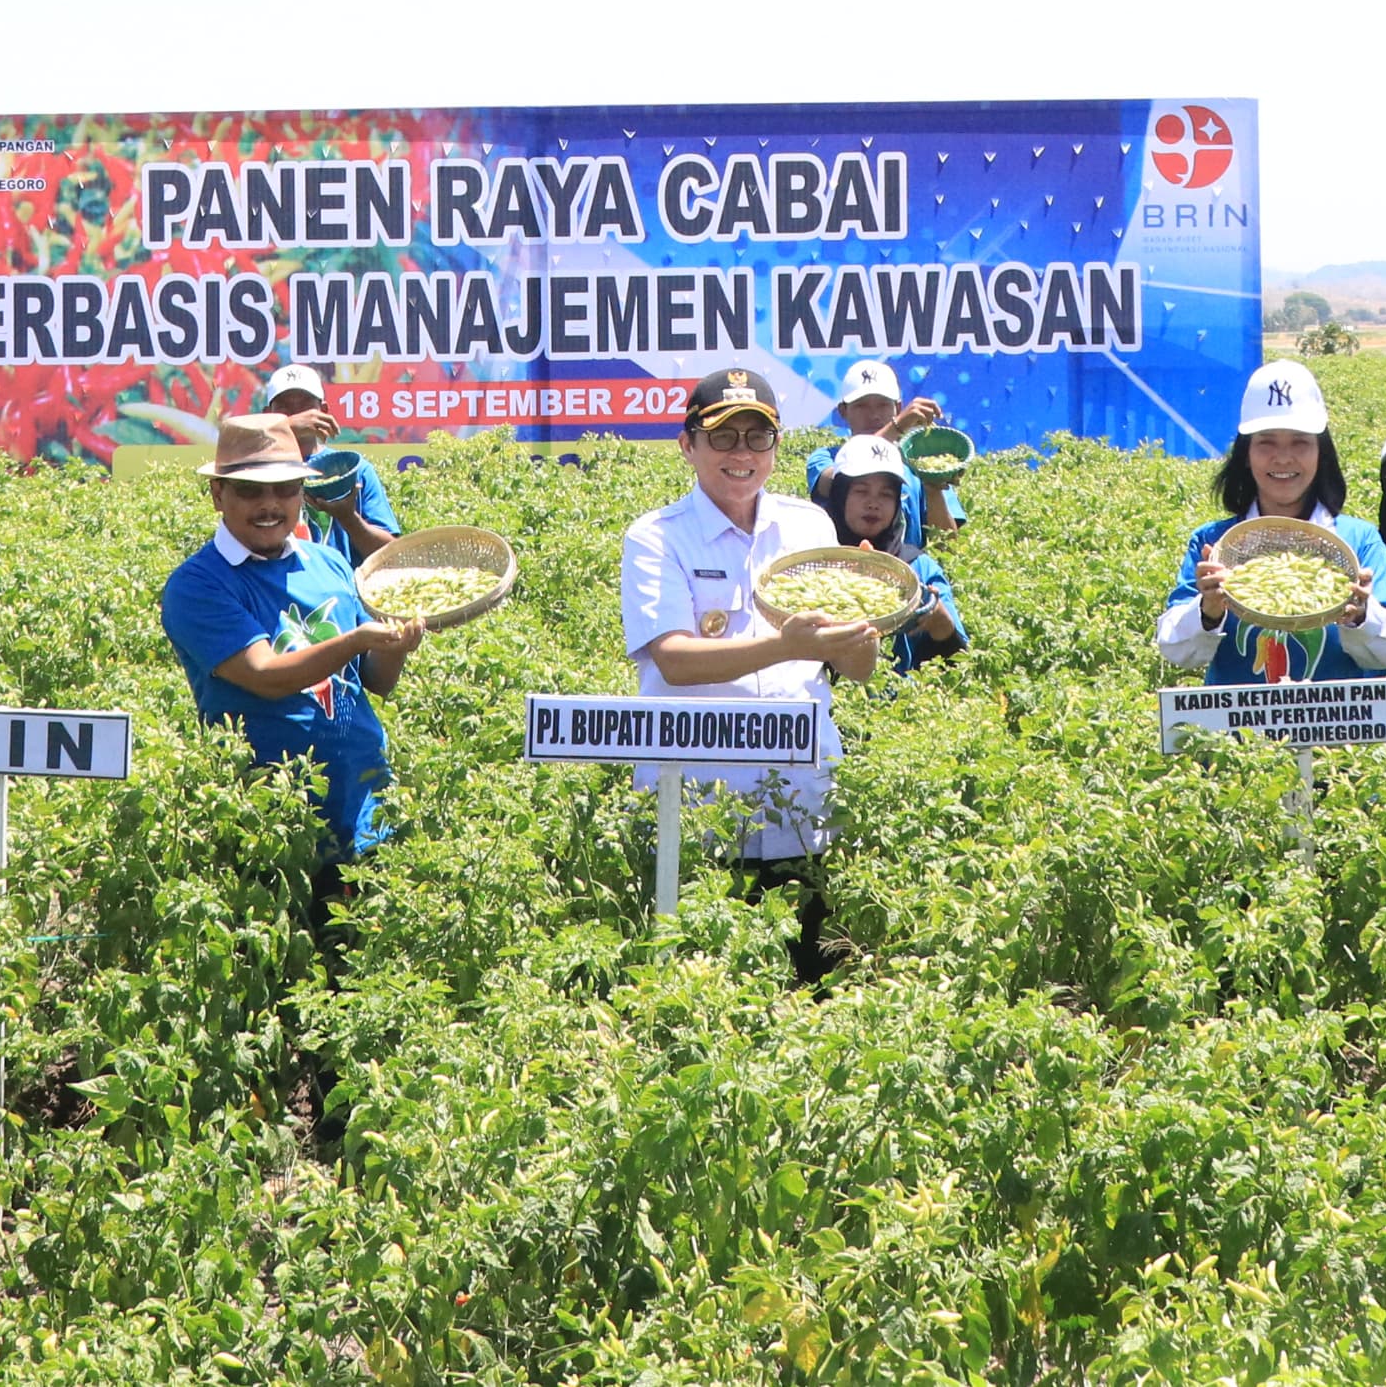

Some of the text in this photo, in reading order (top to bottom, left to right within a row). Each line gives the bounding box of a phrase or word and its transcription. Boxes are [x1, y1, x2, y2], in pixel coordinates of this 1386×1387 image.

[0, 140, 54, 152] PANGAN
[147, 158, 901, 242] PANEN RAYA CABAI
[1143, 204, 1248, 228] BRIN
[295, 273, 749, 356] MANAJEMEN
[777, 268, 1136, 350] KAWASAN
[339, 387, 688, 419] 18 SEPTEMBER 202
[1267, 379, 1294, 408] NY
[1174, 693, 1233, 712] KADIS
[1238, 686, 1345, 707] KETAHANAN
[537, 708, 810, 750] PJ. BUPATI BOJONEGORO
[1228, 705, 1373, 728] DAN PERTANIAN
